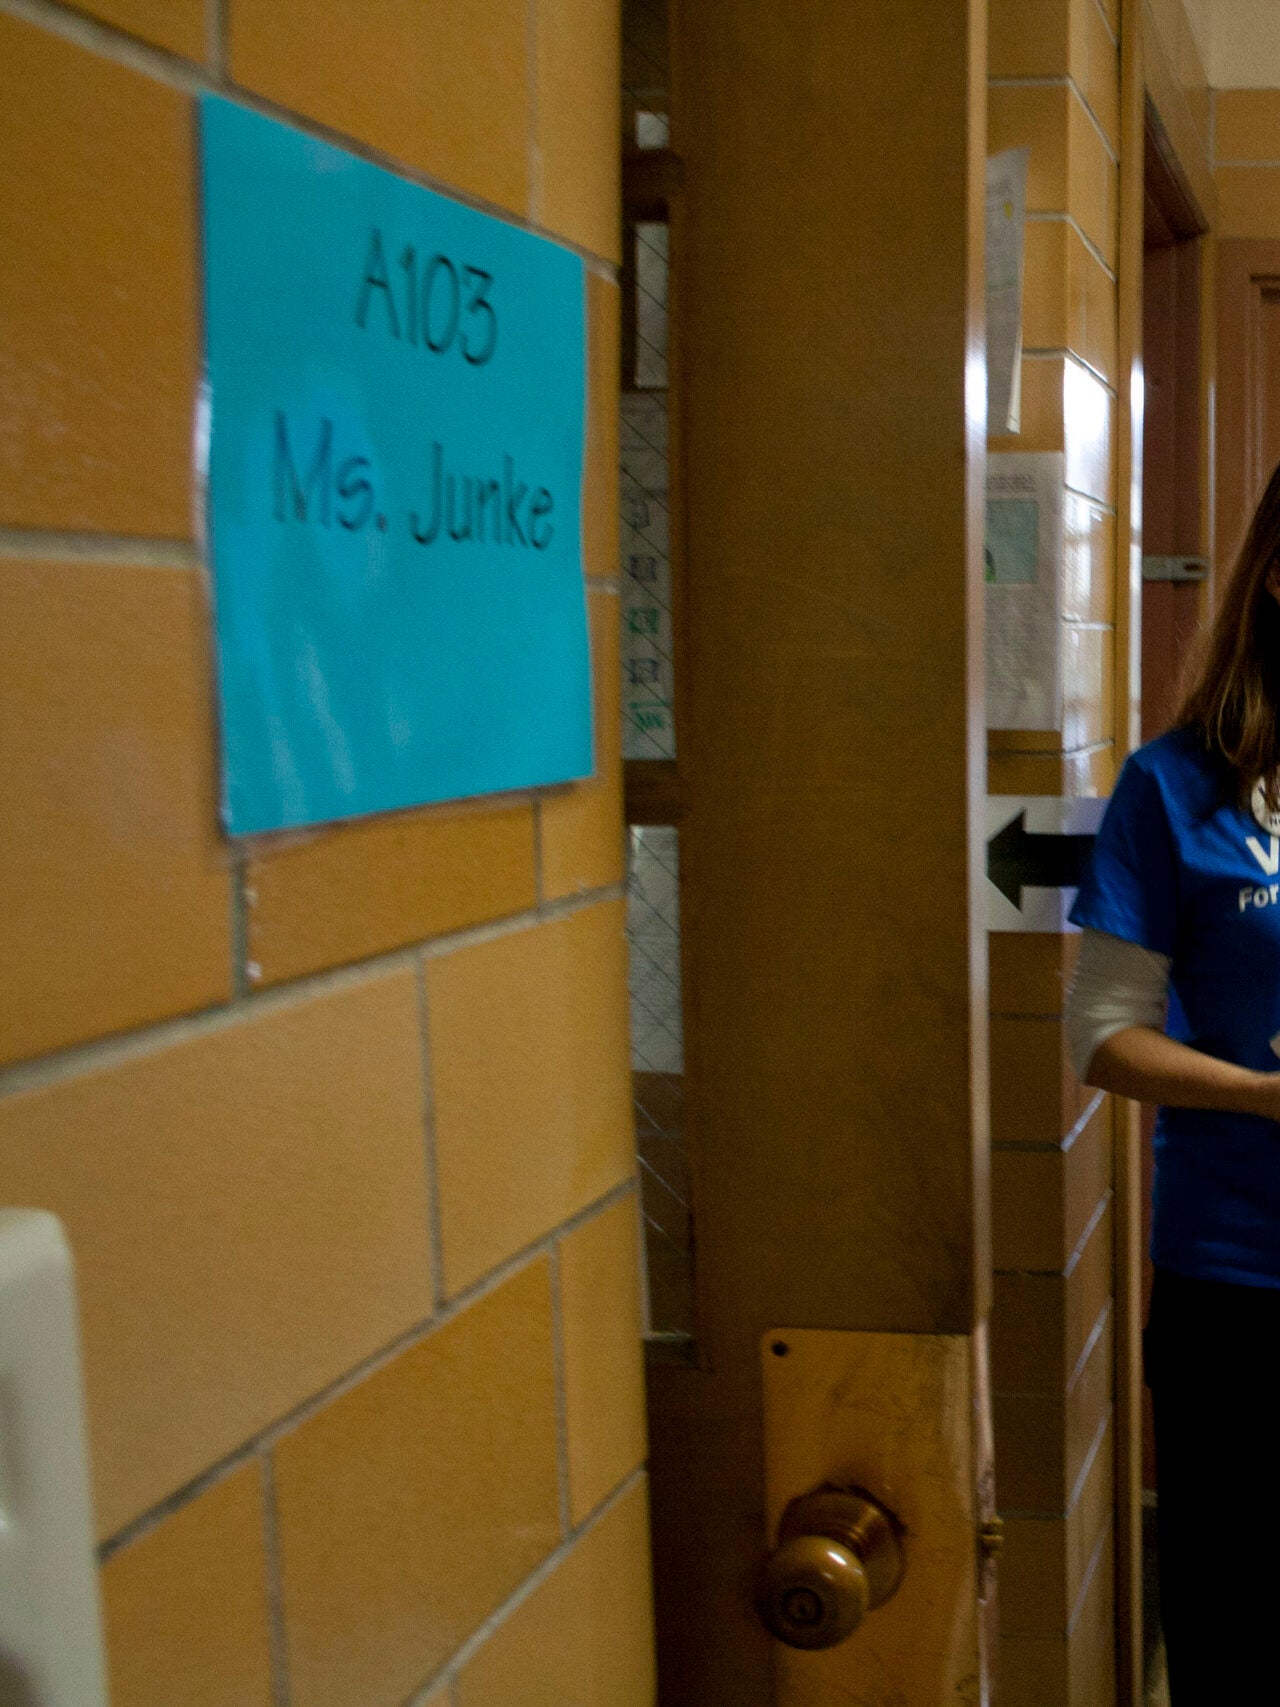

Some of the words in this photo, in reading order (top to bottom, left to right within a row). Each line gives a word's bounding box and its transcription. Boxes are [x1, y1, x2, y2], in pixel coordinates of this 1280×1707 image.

[354, 226, 498, 366] A103
[272, 408, 388, 534] Ms.
[407, 440, 554, 550] Junke
[1238, 884, 1280, 913] For
